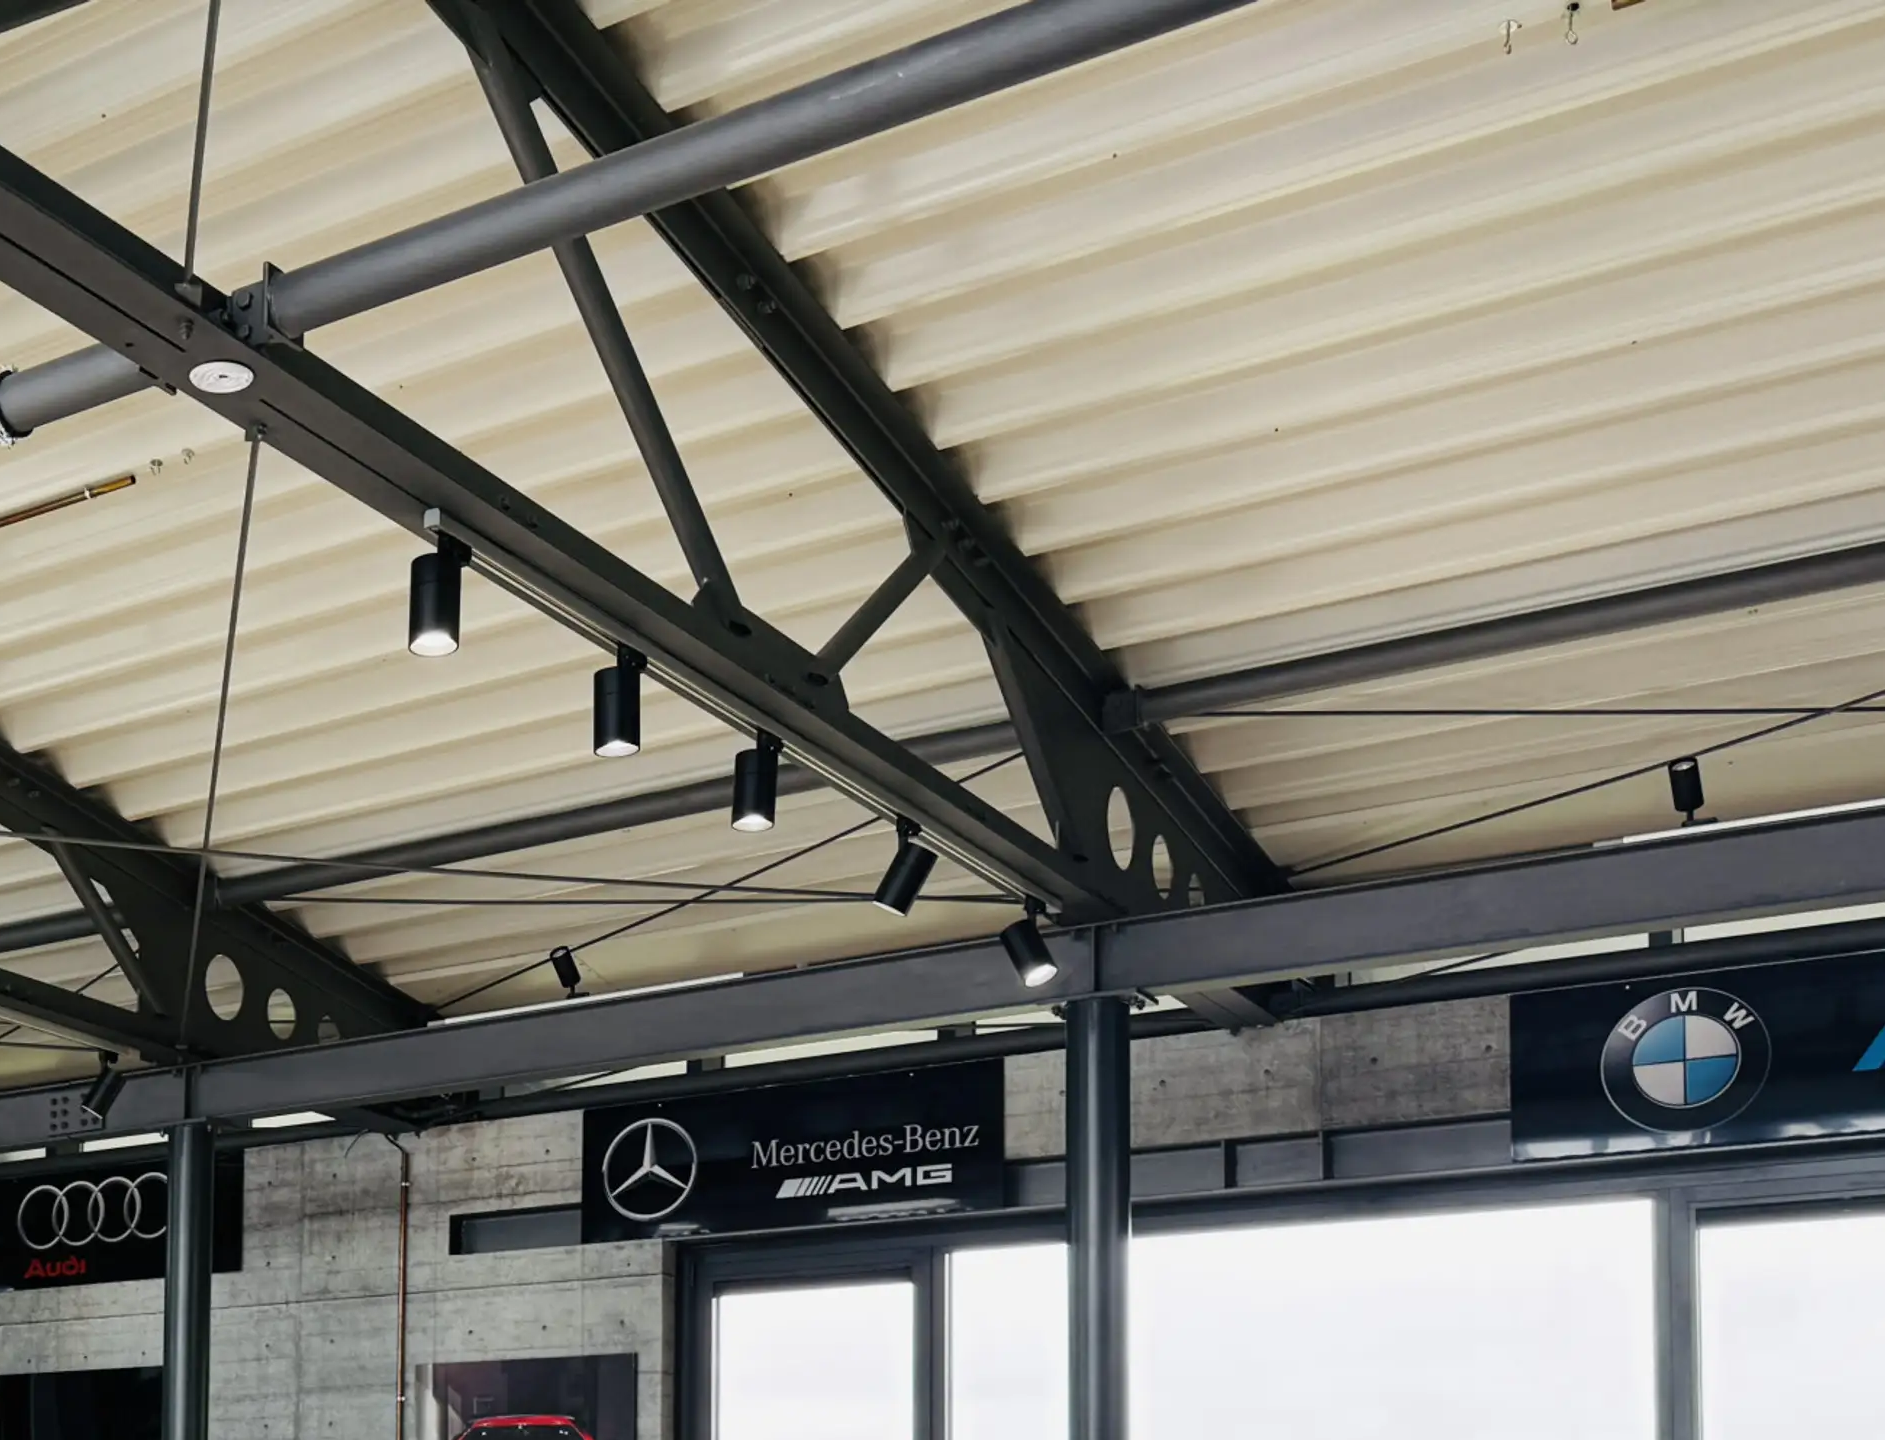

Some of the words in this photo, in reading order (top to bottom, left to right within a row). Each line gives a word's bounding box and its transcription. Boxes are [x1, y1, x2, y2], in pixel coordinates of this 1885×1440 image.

[1617, 991, 1756, 1041] BMW
[750, 1123, 980, 1170] Mercedes-Benz
[23, 1255, 87, 1279] Audi
